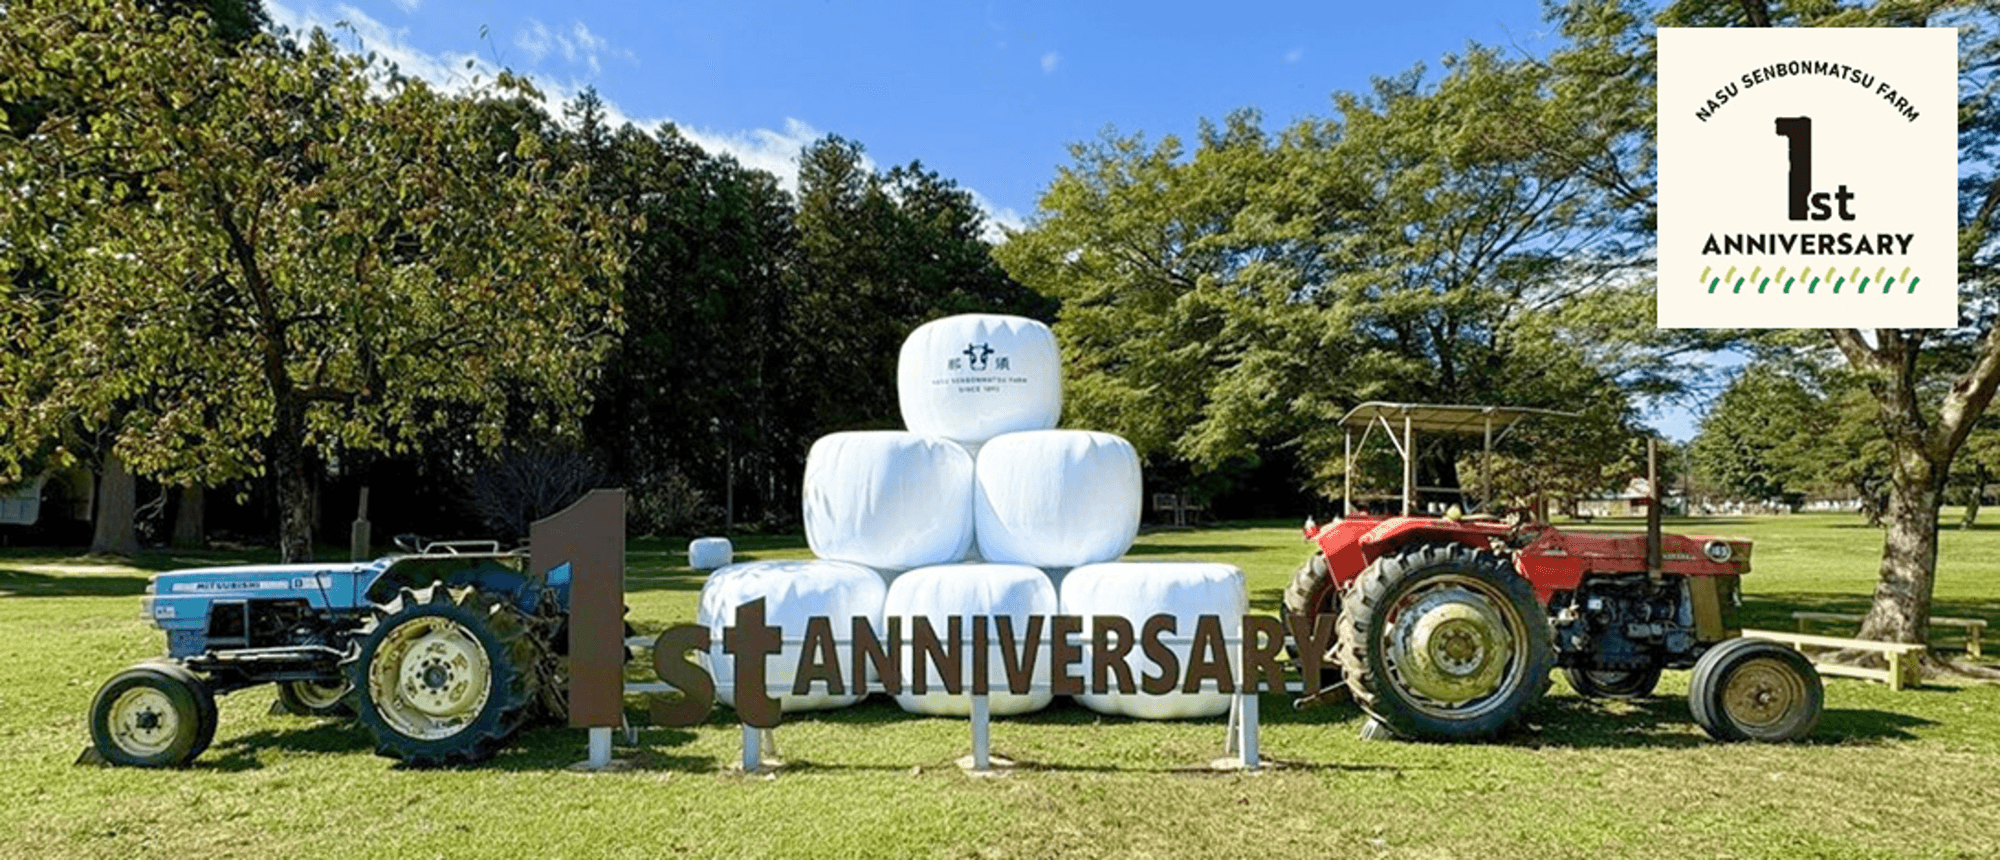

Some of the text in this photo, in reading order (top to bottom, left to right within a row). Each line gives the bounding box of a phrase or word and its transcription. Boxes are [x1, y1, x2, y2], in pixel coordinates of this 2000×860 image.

[196, 581, 261, 590] MITSUBISHI
[530, 488, 1338, 728] 1st ANNIVERSARY
